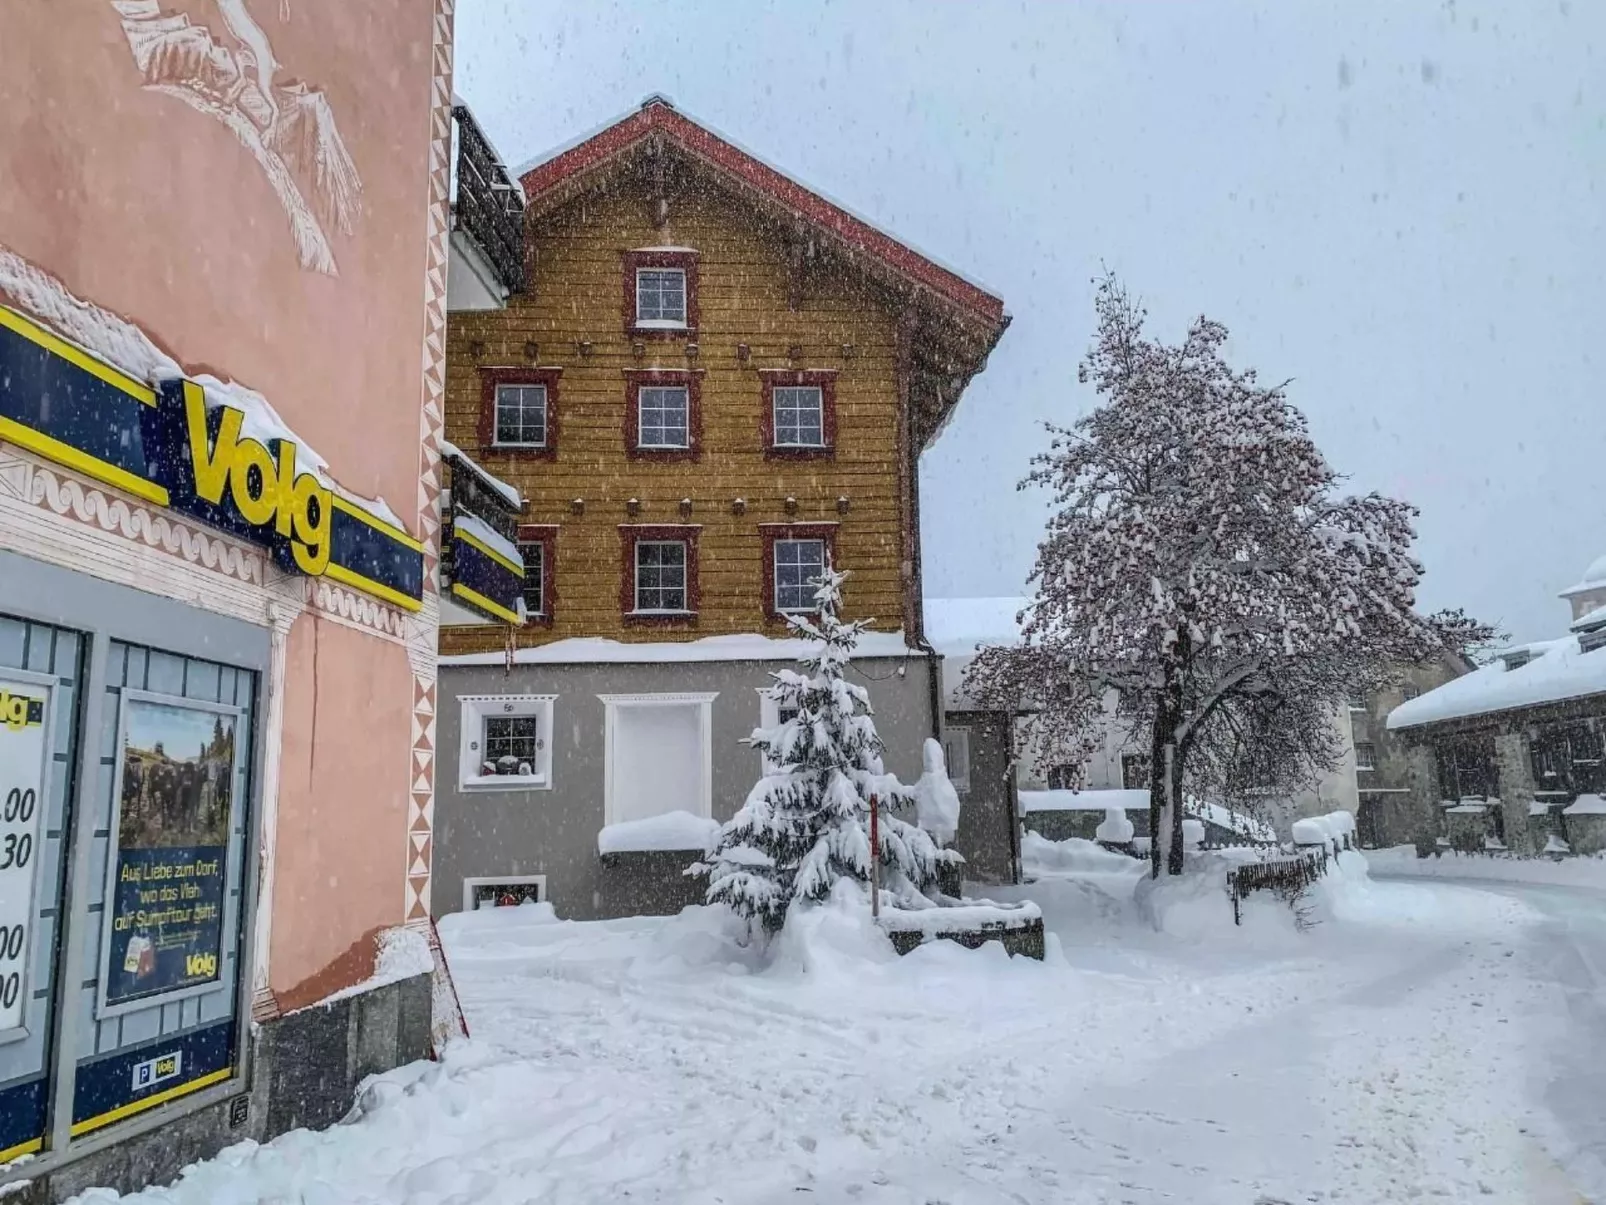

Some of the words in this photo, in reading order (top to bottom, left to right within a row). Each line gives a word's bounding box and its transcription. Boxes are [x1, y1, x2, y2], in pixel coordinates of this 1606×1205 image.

[183, 380, 333, 576] Volg
[0, 689, 28, 731] lg
[120, 863, 141, 882] Aus
[143, 863, 173, 881] Liebe
[175, 863, 195, 879] zum
[141, 889, 158, 904] wo
[160, 884, 179, 901] das
[186, 952, 217, 977] Volg
[156, 1058, 175, 1076] Volg
